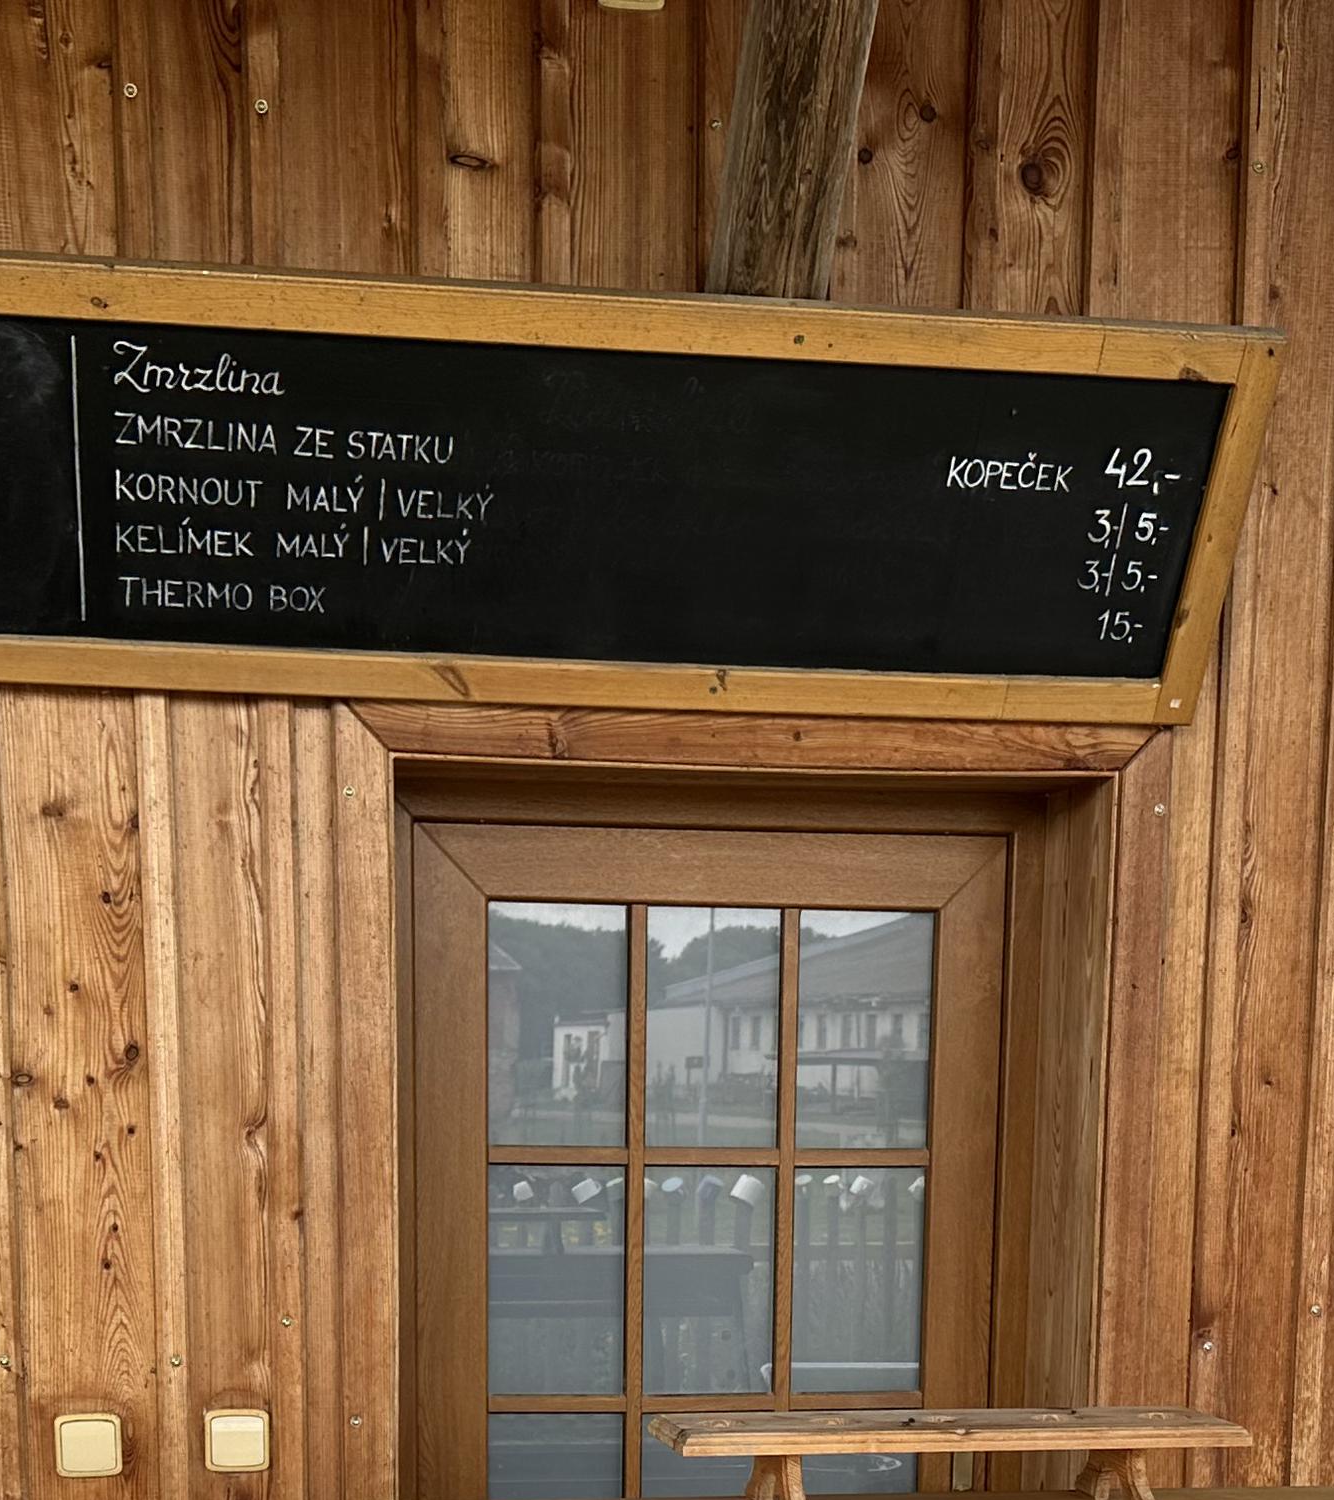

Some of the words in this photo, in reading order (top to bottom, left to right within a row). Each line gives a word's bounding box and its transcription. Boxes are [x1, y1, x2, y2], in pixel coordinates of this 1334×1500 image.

[113, 340, 286, 396] Zmrzlina
[114, 411, 278, 457] ZMRZLINA
[293, 425, 335, 459] ZE
[347, 430, 454, 465] STATKU
[114, 468, 264, 509] KORNOUT
[286, 474, 366, 515] MALÝ
[397, 483, 495, 523] VELKÝ
[946, 451, 1074, 493] KOPEČEK
[1104, 447, 1182, 495] 42,-
[115, 515, 255, 559] KELÍMEK
[275, 522, 351, 560] MALÝ
[380, 528, 473, 566] VELKÝ
[118, 576, 254, 613] THERMO
[269, 584, 328, 615] BOX
[1096, 608, 1144, 644] 15,-
